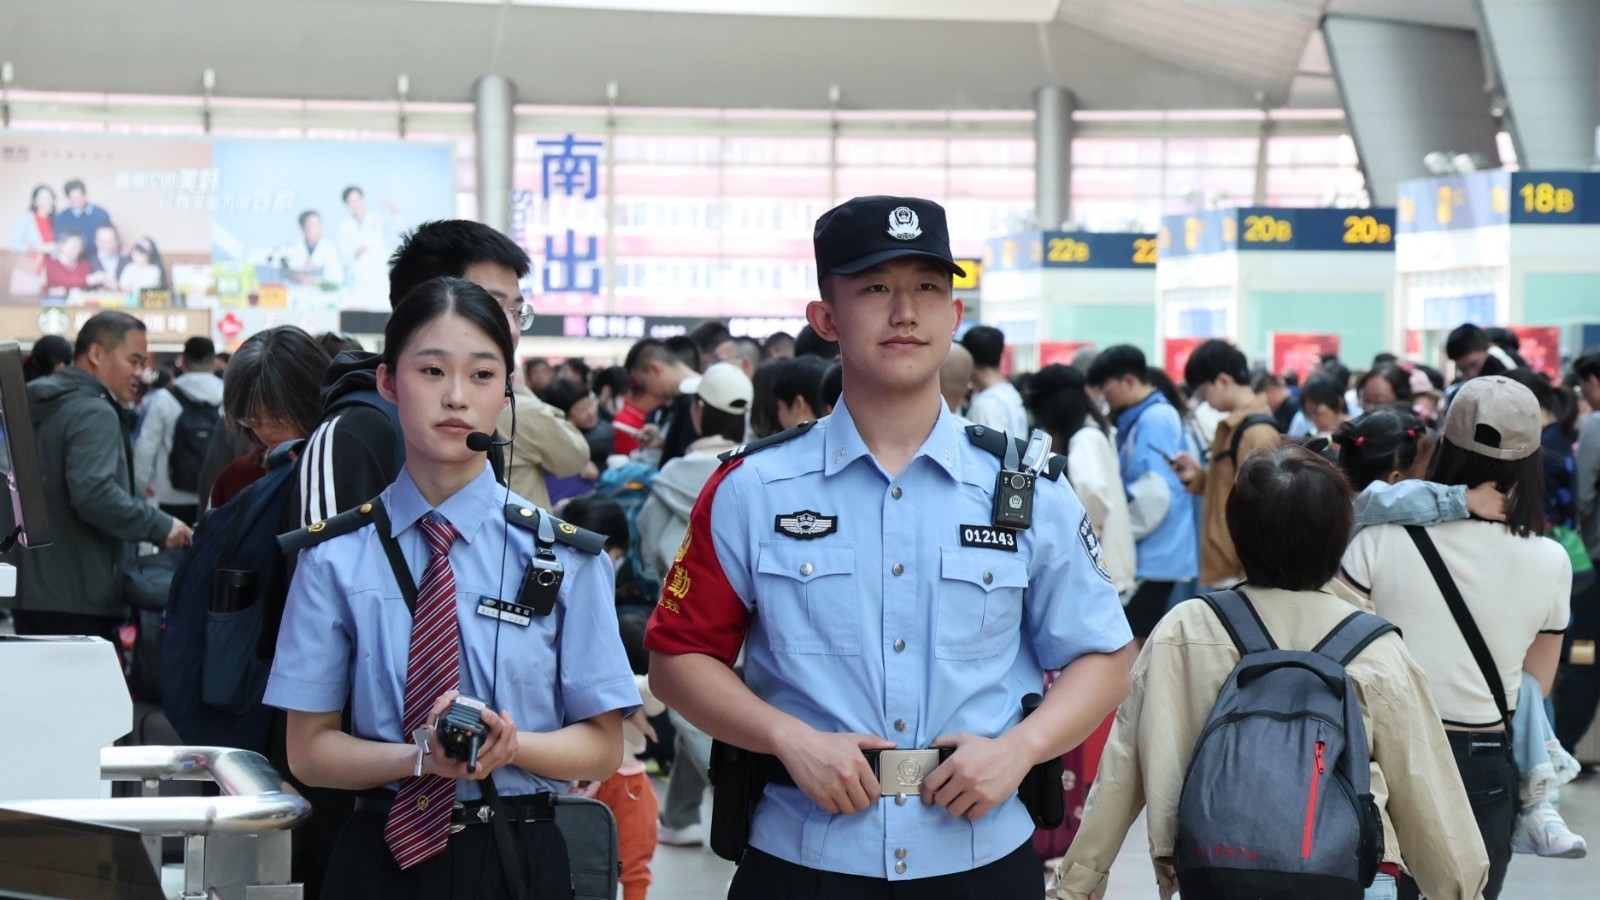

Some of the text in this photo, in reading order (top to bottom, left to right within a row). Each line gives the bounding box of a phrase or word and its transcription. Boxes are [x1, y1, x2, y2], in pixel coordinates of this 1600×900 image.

[1520, 182, 1574, 213] 18B
[536, 134, 603, 295] 南出
[1243, 215, 1292, 242] 20B
[1343, 215, 1391, 243] 20B
[1047, 238, 1090, 262] 22B
[965, 529, 1014, 546] 012143
